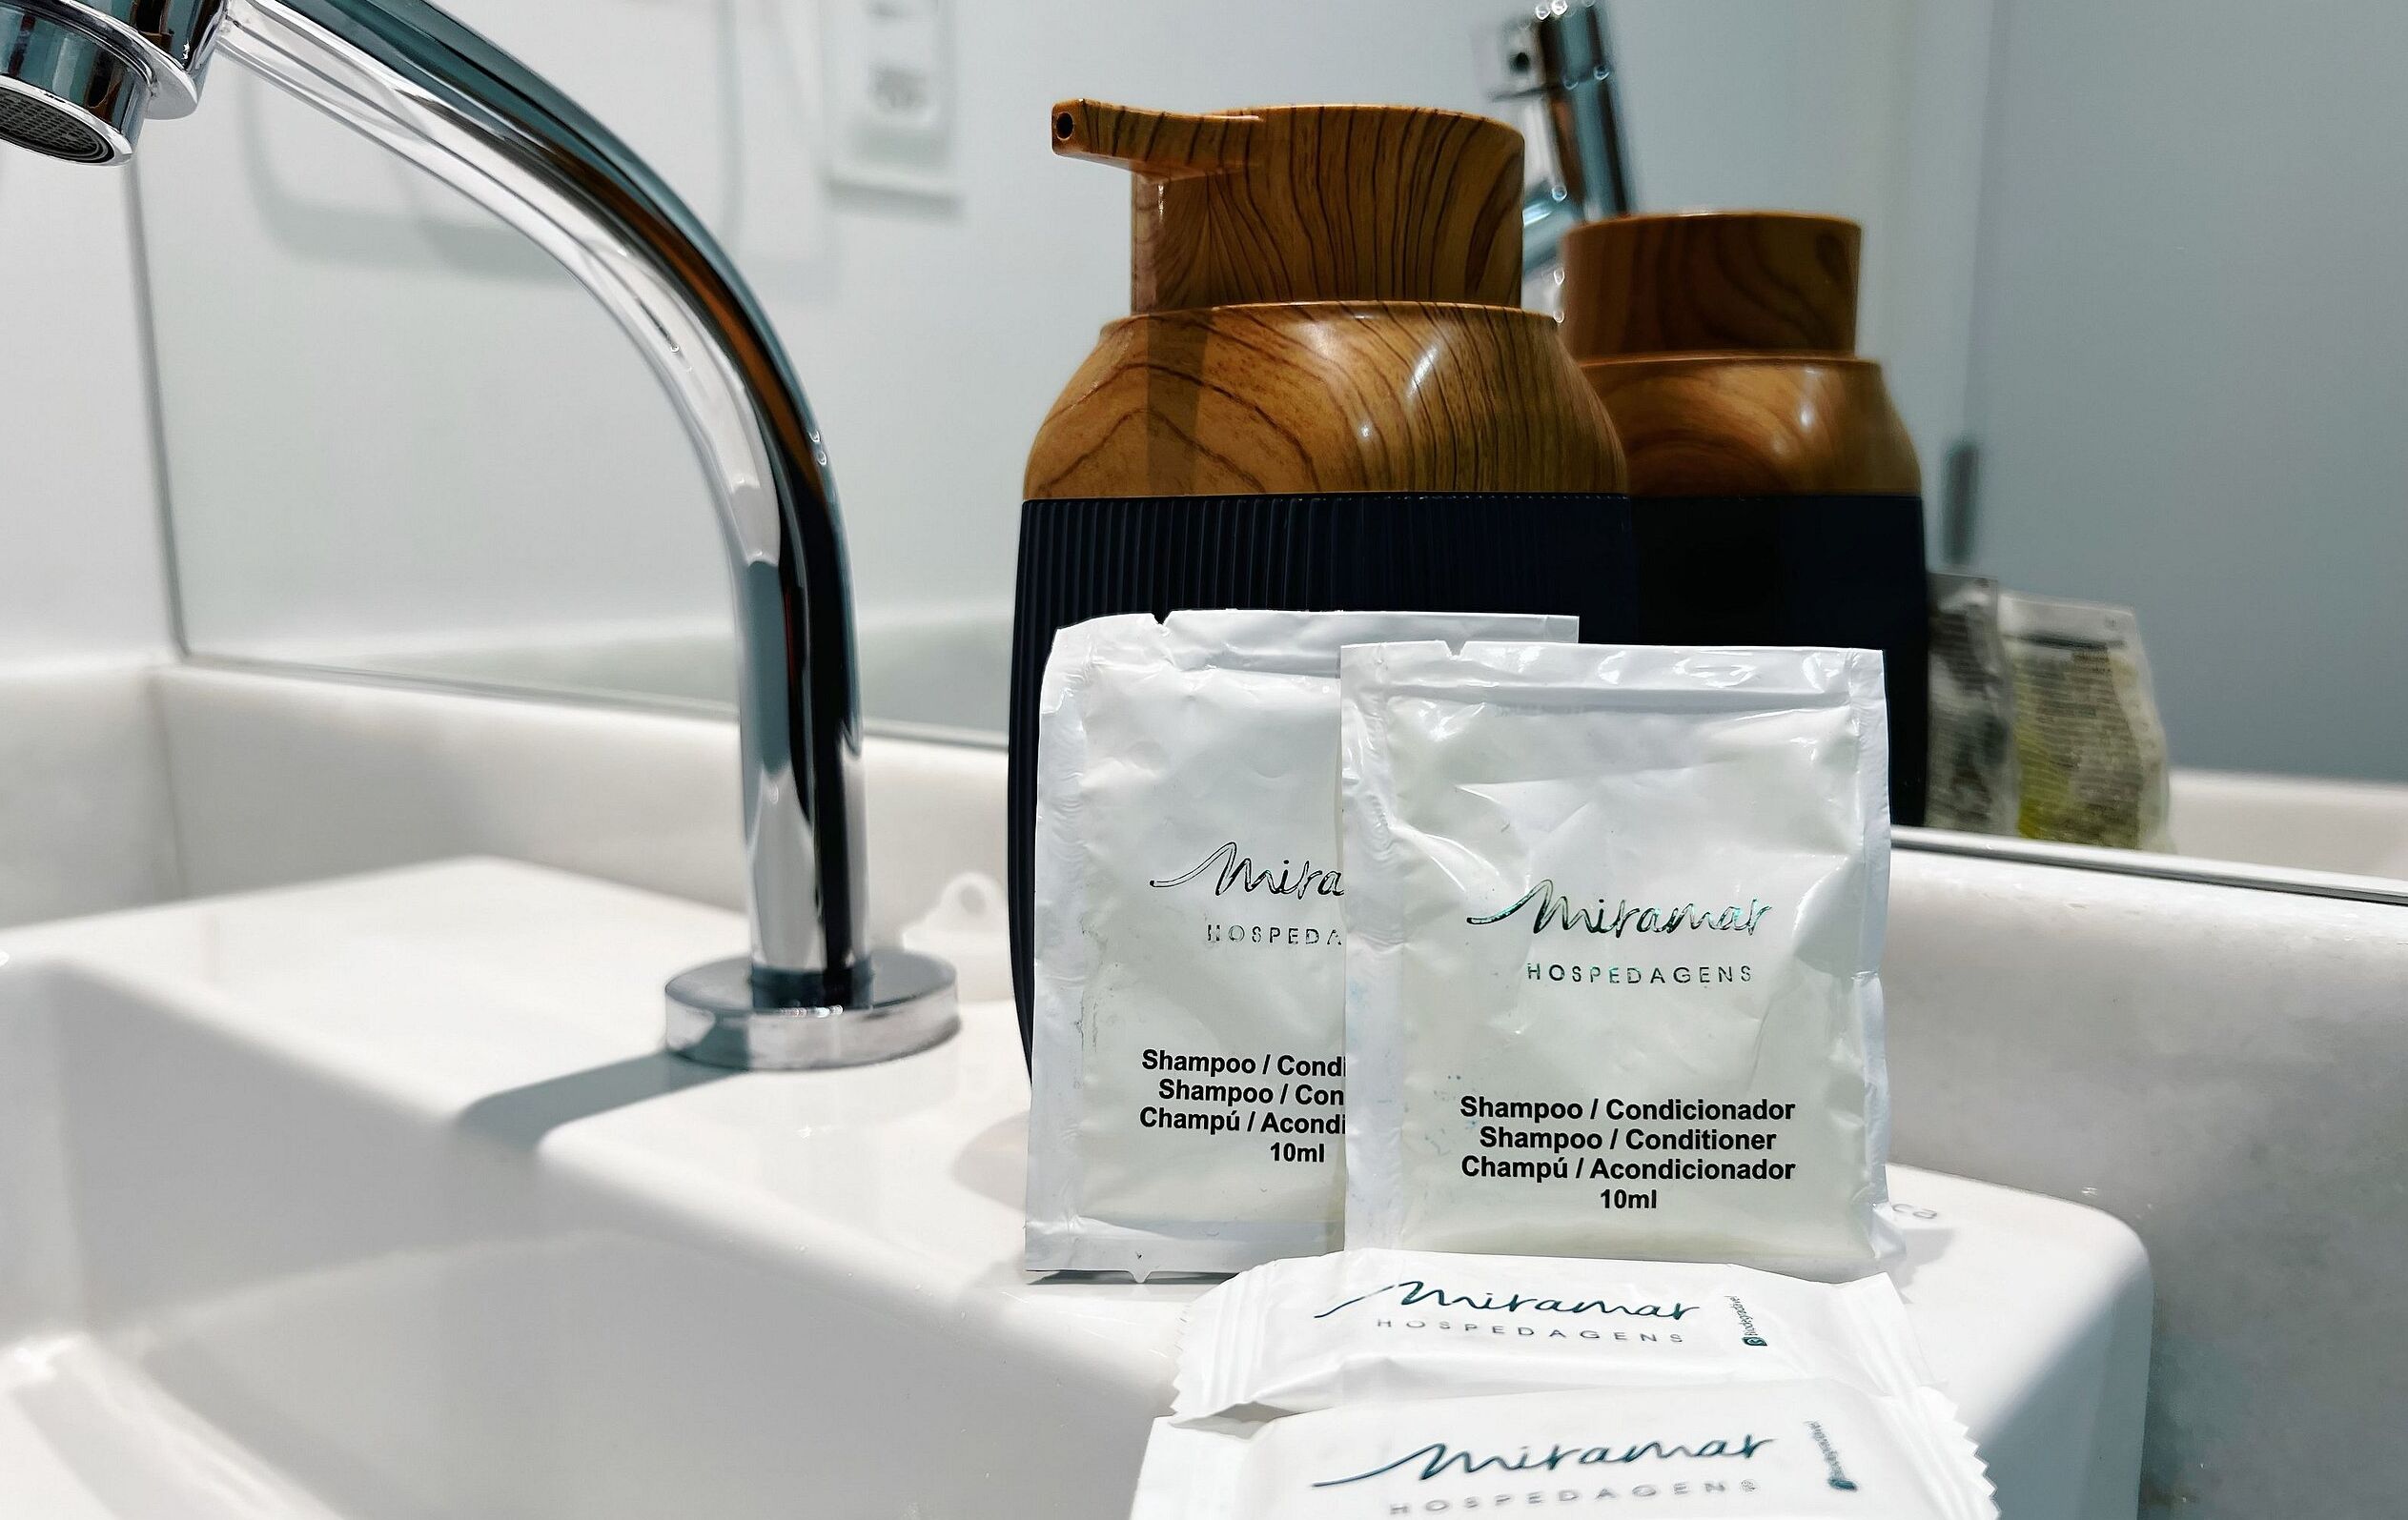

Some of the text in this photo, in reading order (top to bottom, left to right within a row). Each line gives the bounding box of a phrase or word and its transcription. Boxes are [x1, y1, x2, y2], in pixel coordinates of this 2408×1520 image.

[1207, 924, 1342, 945] HOSPEDA
[1527, 963, 1752, 984] HOSPEDAGENS
[1142, 1048, 1256, 1075] Shampoo
[1262, 1054, 1271, 1074] /
[1158, 1079, 1274, 1106] Shampoo
[1279, 1084, 1288, 1105] /
[1140, 1107, 1240, 1134] Champú
[1247, 1111, 1255, 1132] /
[1460, 1096, 1796, 1124] Shampoo / Condicionador
[1270, 1143, 1325, 1163] 10ml
[1479, 1126, 1777, 1153] Shampoo / Conditioner
[1461, 1155, 1796, 1183] Champú / Acondicionador
[1600, 1189, 1657, 1209] 10ml
[1377, 1319, 1684, 1343] HOSPEDAGENS
